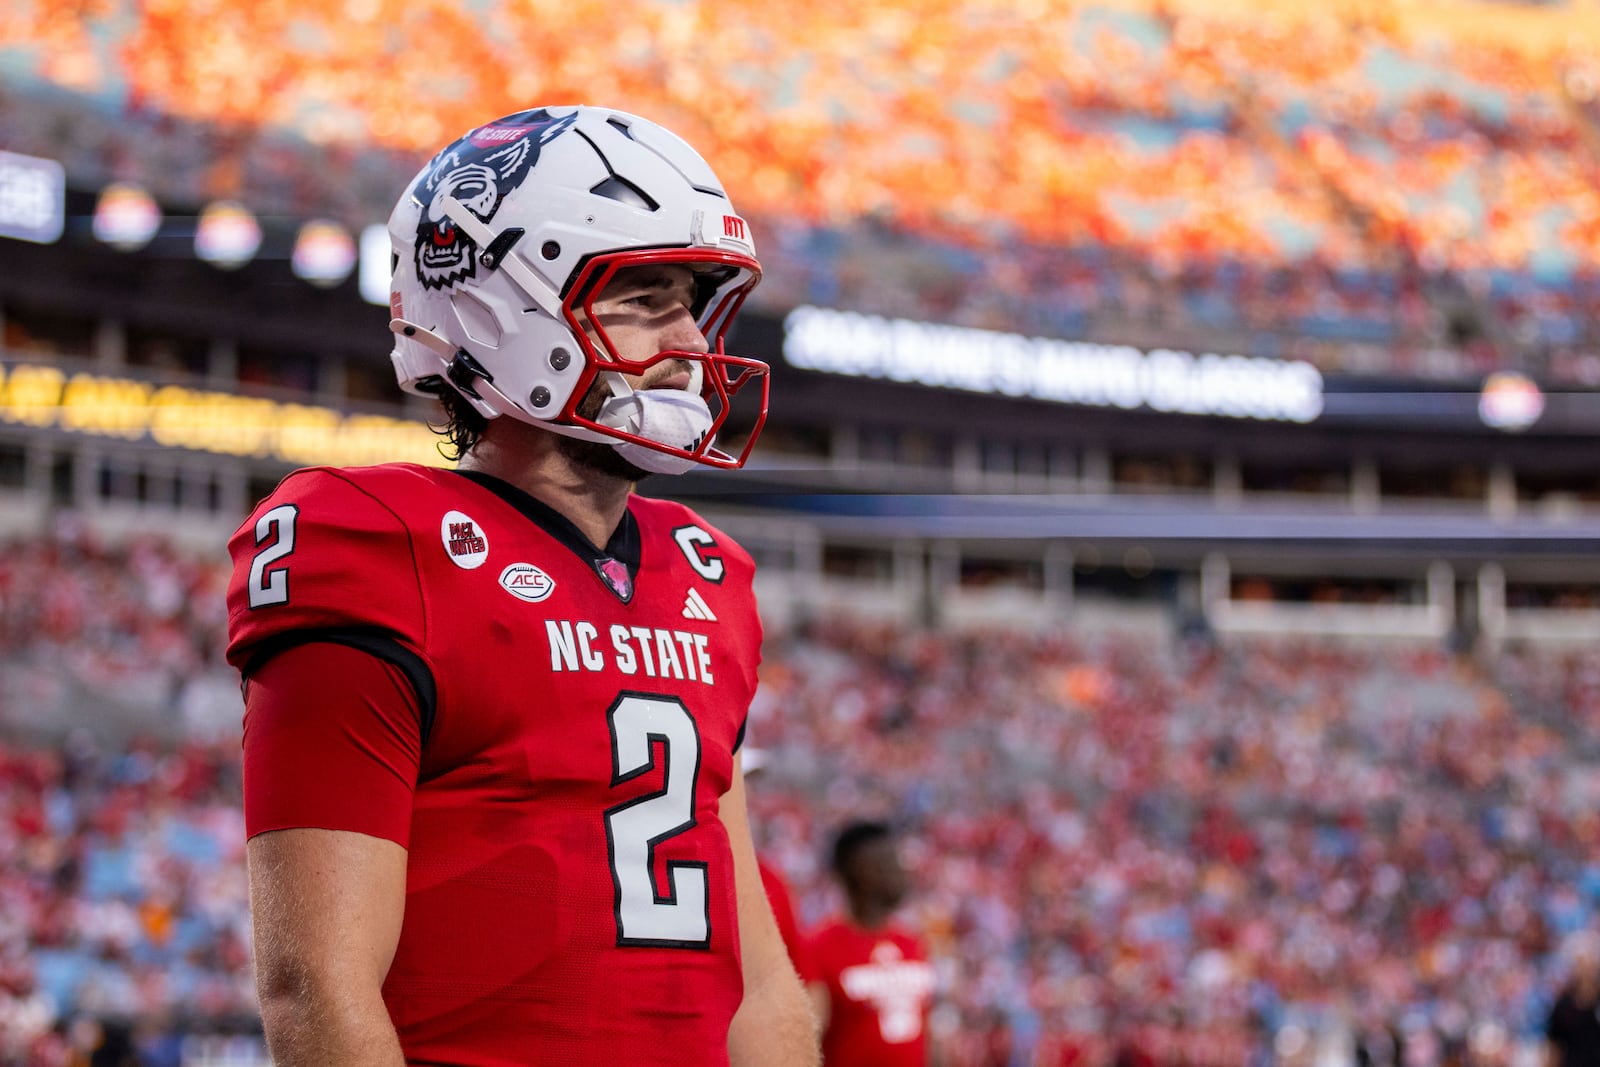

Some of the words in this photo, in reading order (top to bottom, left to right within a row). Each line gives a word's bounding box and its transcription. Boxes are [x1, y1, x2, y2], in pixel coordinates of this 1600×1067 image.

[486, 129, 527, 141] STATE
[449, 522, 475, 540] PACK
[449, 537, 485, 556] UNITED
[248, 503, 300, 611] 2
[671, 524, 726, 586] C
[511, 575, 544, 586] ACC
[544, 619, 605, 672] NC
[609, 623, 715, 685] STATE
[603, 689, 712, 949] 2
